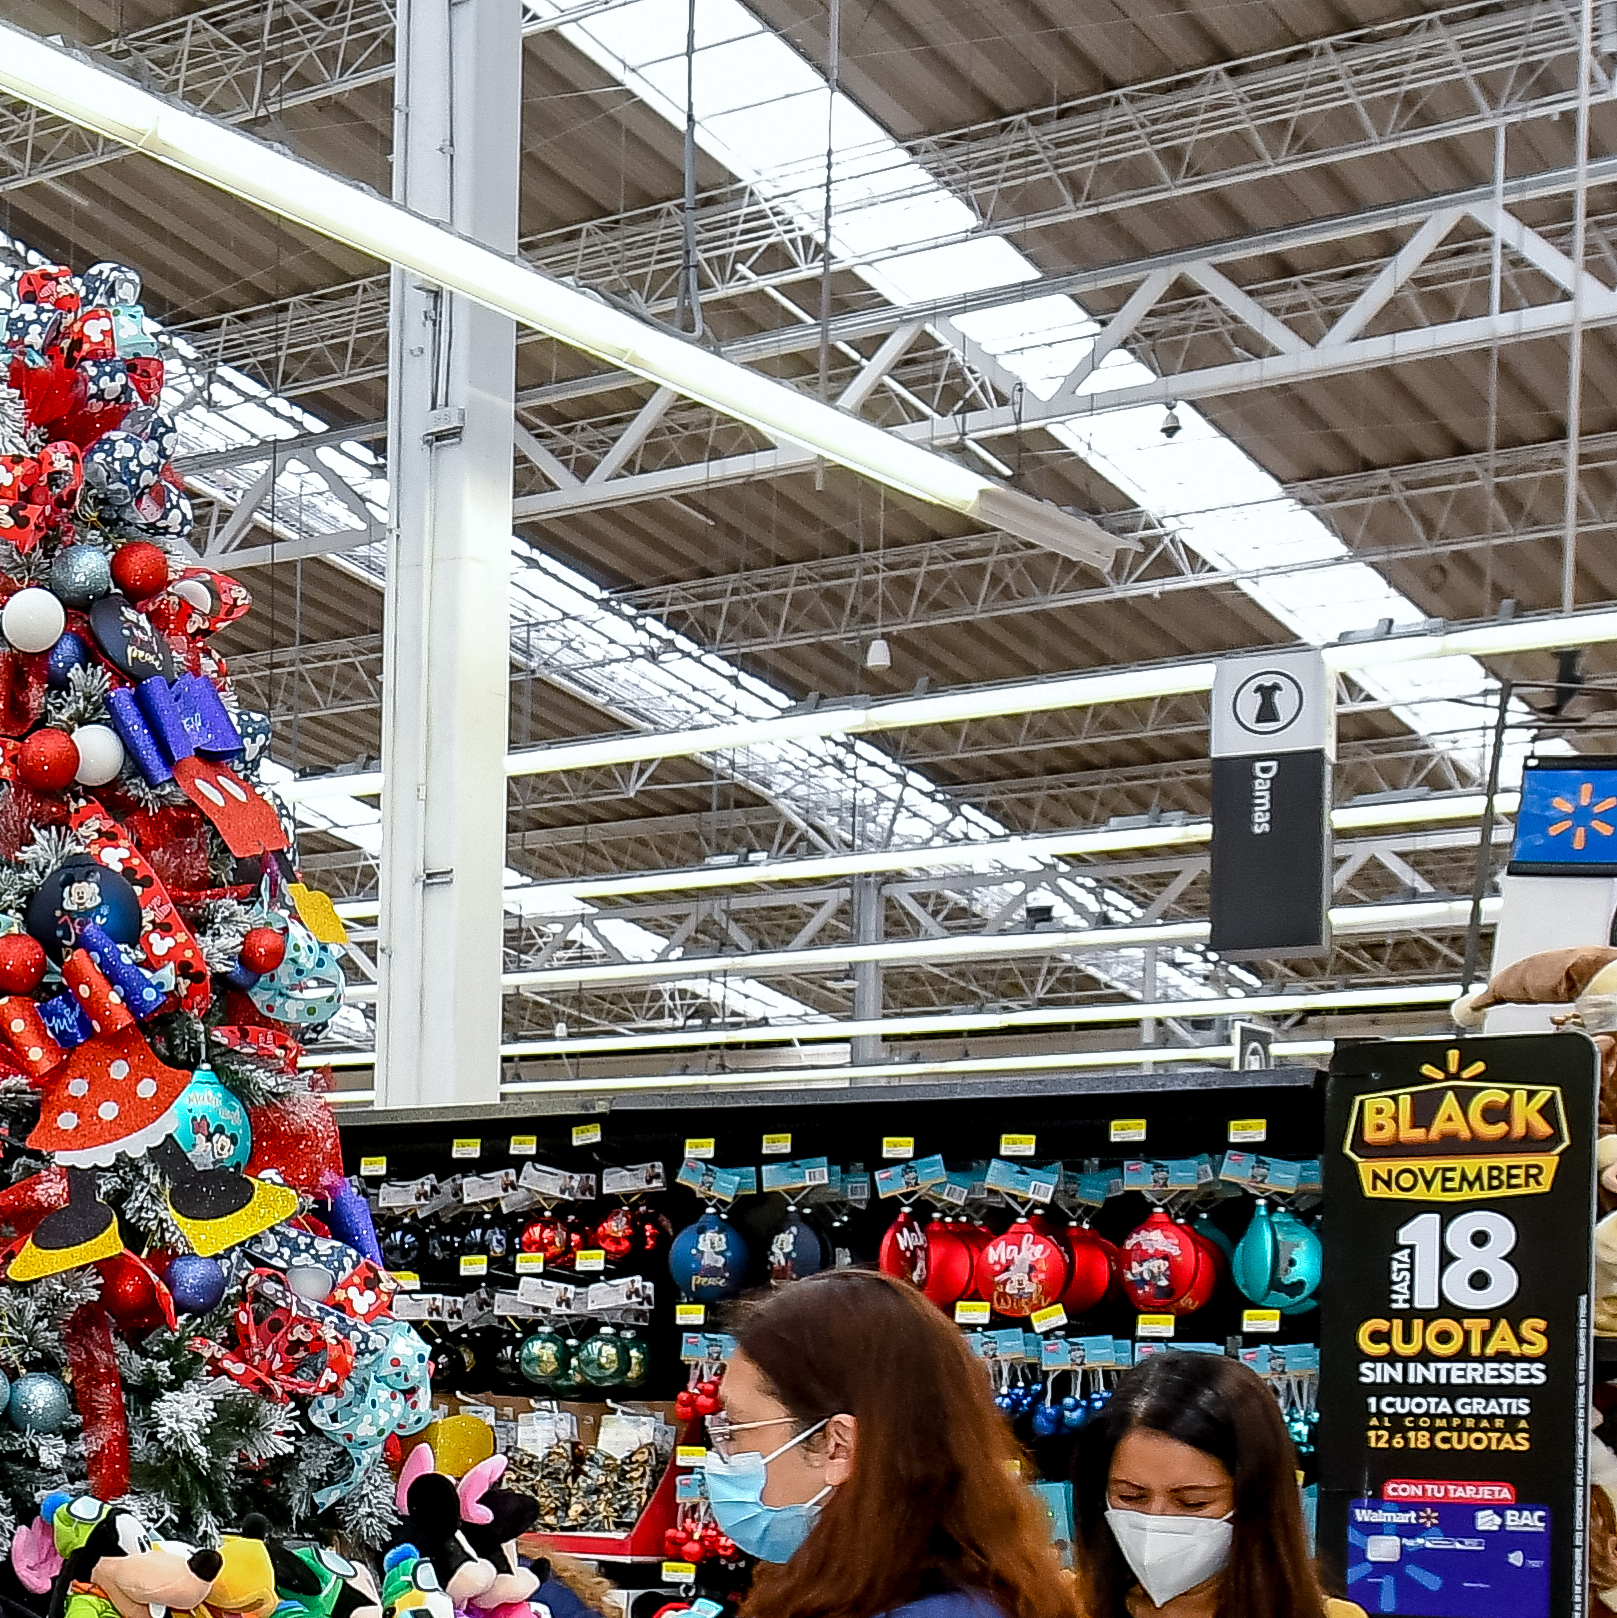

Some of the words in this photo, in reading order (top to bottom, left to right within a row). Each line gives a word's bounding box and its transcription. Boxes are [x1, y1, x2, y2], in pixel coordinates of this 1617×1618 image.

[1252, 761, 1279, 835] Damas
[1363, 1089, 1554, 1146] BLACK
[1371, 1164, 1544, 1193] NOVEMBER
[988, 1233, 1051, 1264] Make
[1396, 1210, 1519, 1310] 18
[1389, 1248, 1411, 1310] HASTA
[1357, 1318, 1550, 1357] CUOTAS
[1358, 1362, 1403, 1384] SIN
[1407, 1362, 1547, 1385] INTERESES
[1367, 1397, 1377, 1414] 1
[1379, 1397, 1453, 1414] CUOTA
[1455, 1398, 1531, 1415] GRATIS
[1369, 1417, 1391, 1427] AL
[1404, 1417, 1506, 1429] COMPRAR
[1517, 1418, 1530, 1429] A
[1367, 1431, 1389, 1448] 12
[1408, 1431, 1431, 1449] 18
[1434, 1432, 1531, 1450] CUOTAS
[1386, 1484, 1423, 1497] CON
[1425, 1485, 1445, 1498] TU
[1449, 1485, 1512, 1500] TARJETA
[1354, 1508, 1417, 1523] Walmart
[1504, 1510, 1547, 1526] BAC
